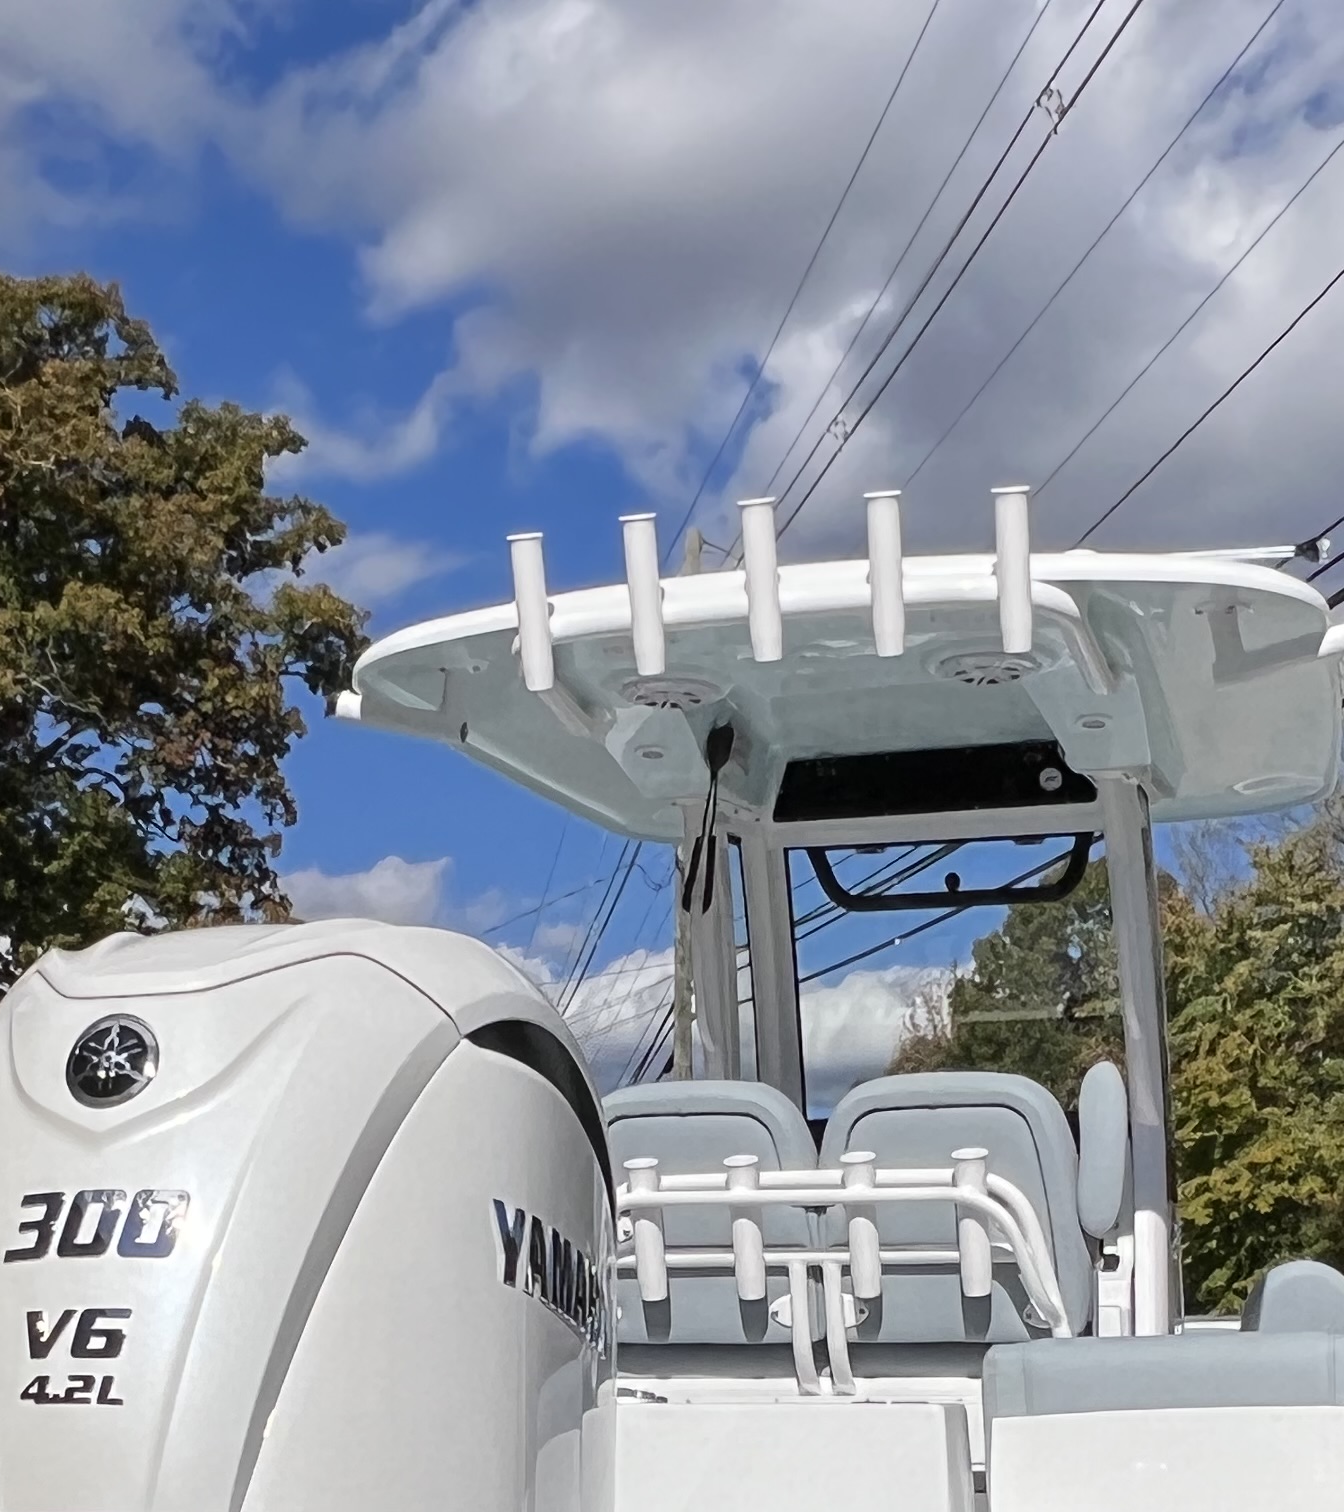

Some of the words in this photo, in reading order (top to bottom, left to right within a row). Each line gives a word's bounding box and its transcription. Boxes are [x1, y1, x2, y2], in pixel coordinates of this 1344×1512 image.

[3, 1189, 191, 1263] 300
[492, 1198, 606, 1357] YAMAH
[26, 1308, 133, 1360] V6
[20, 1374, 124, 1405] 4.2L
